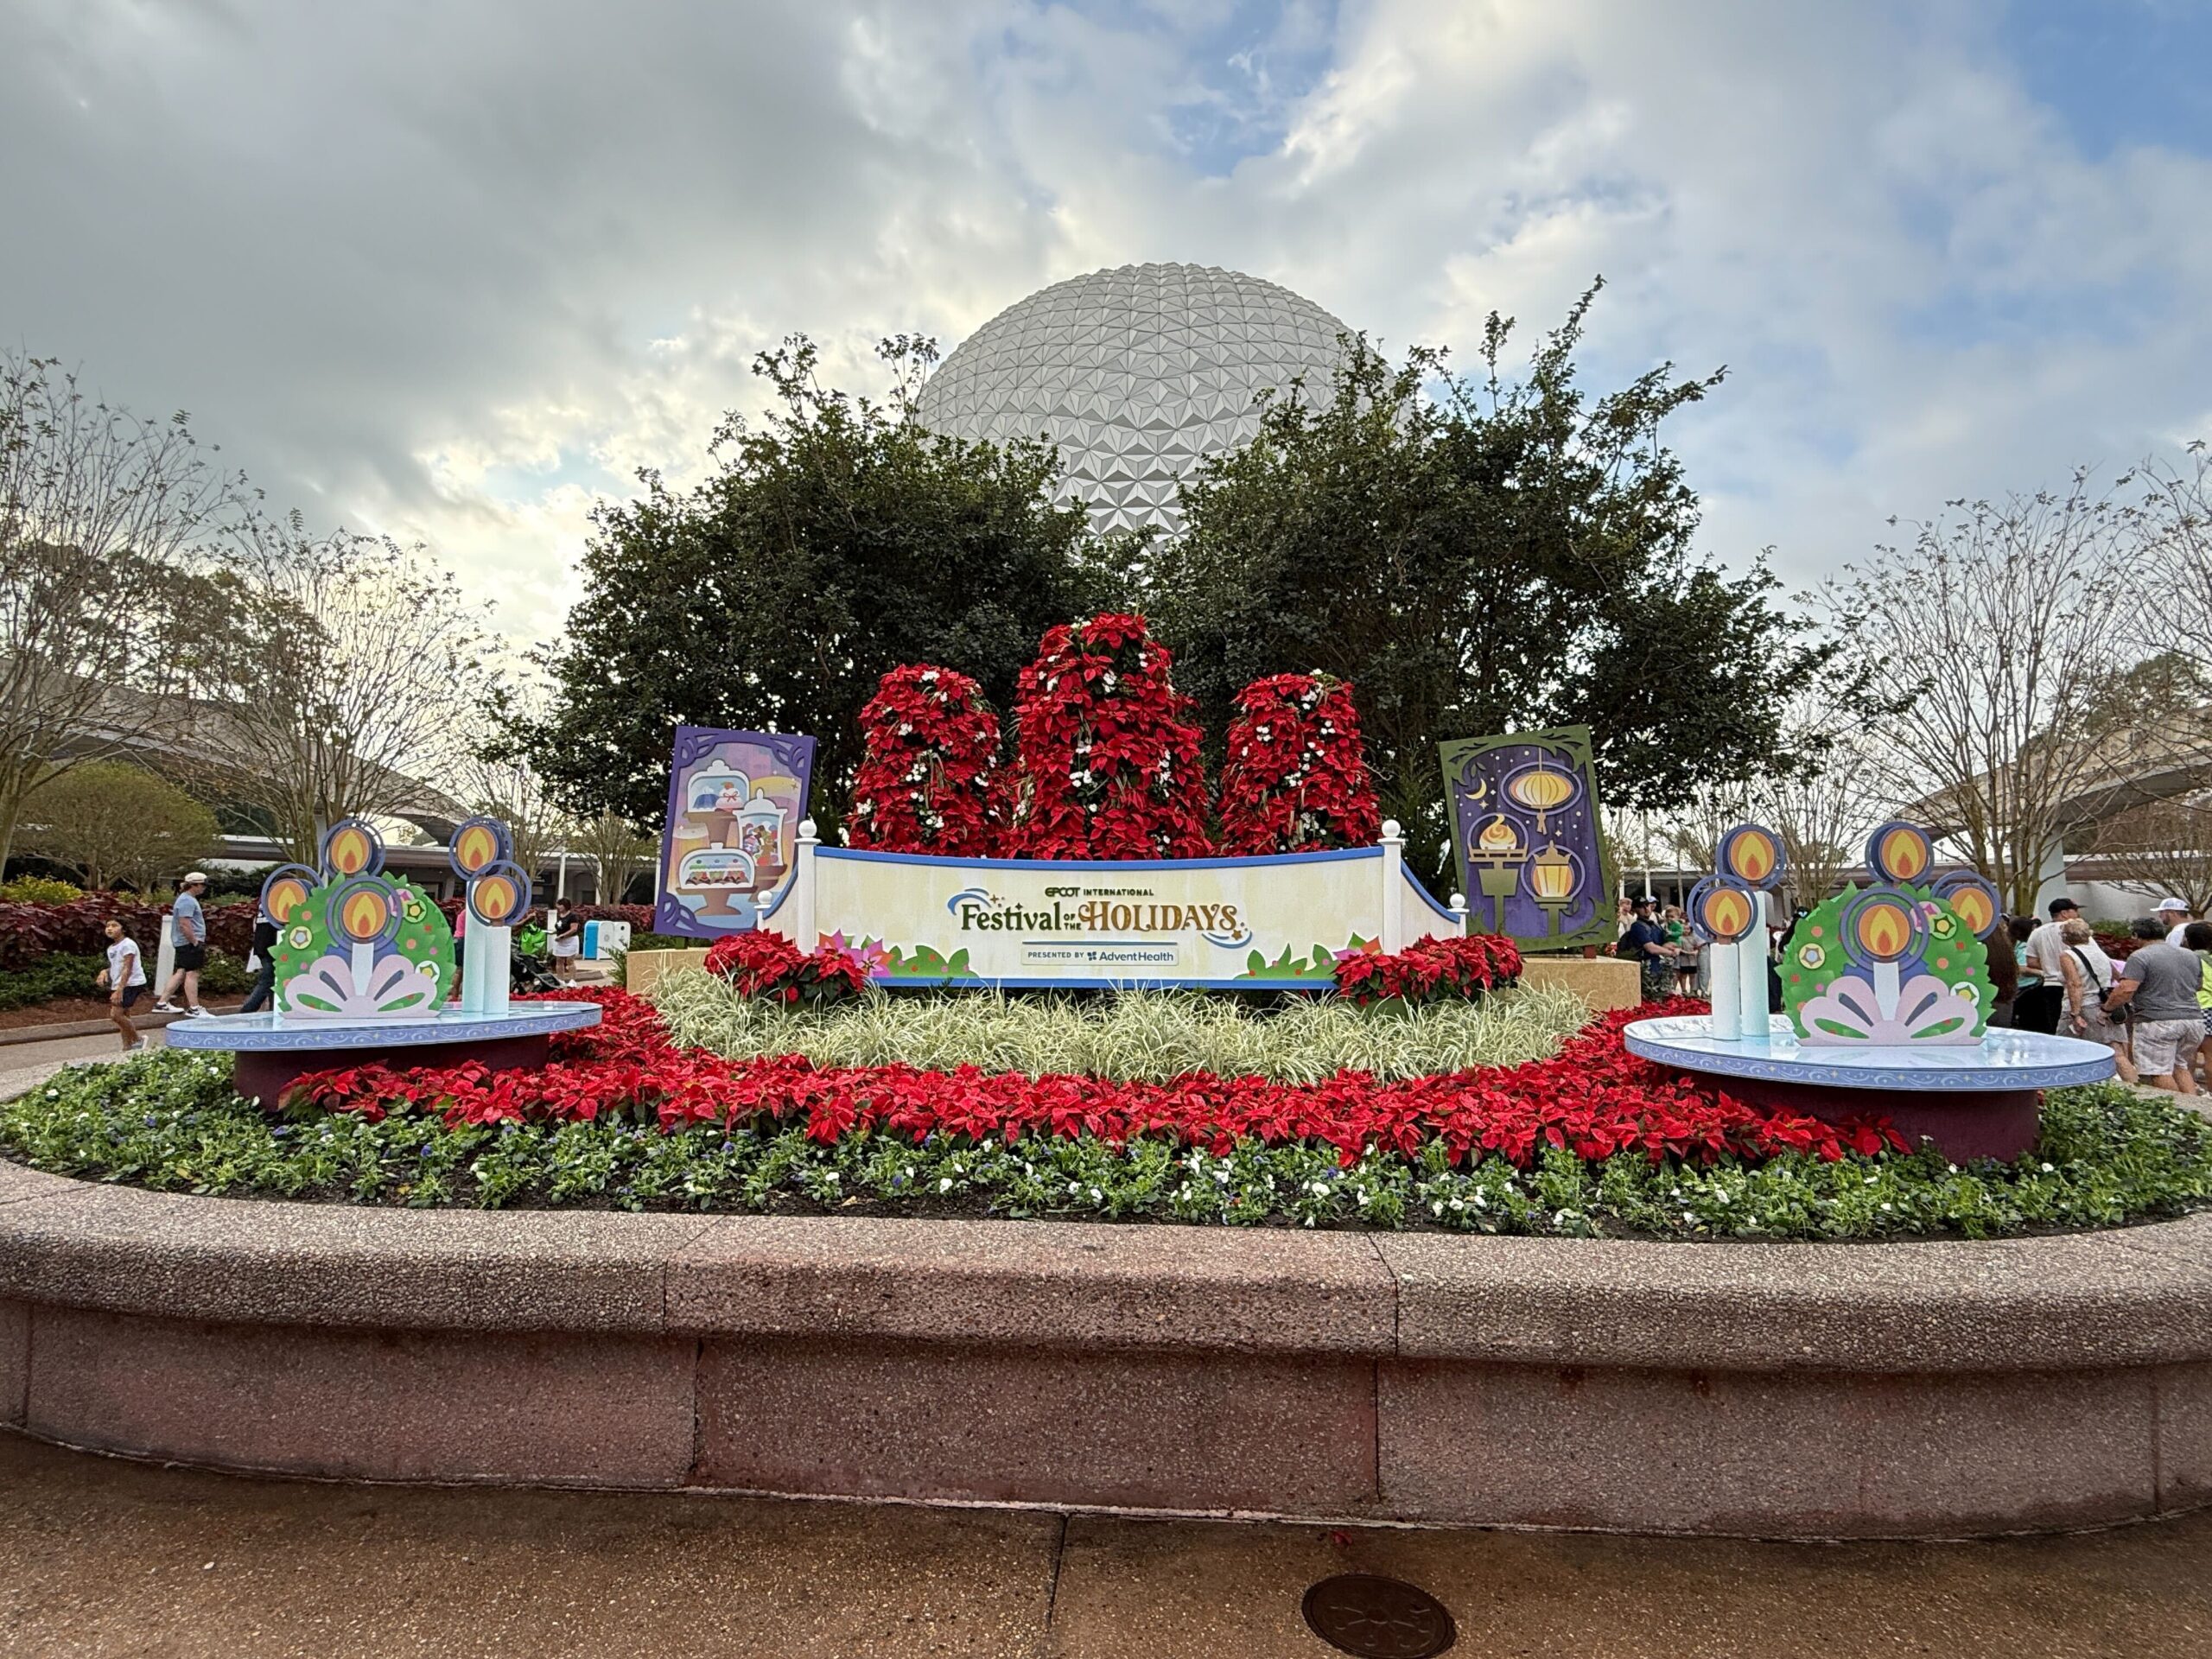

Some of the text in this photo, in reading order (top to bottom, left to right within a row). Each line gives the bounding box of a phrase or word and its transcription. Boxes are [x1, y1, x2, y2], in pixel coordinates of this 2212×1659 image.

[1045, 887, 1081, 898] EPCOT
[961, 901, 1063, 931] Festival
[1077, 900, 1238, 932] HOLIDAYS
[1098, 951, 1174, 962] AdventHealth
